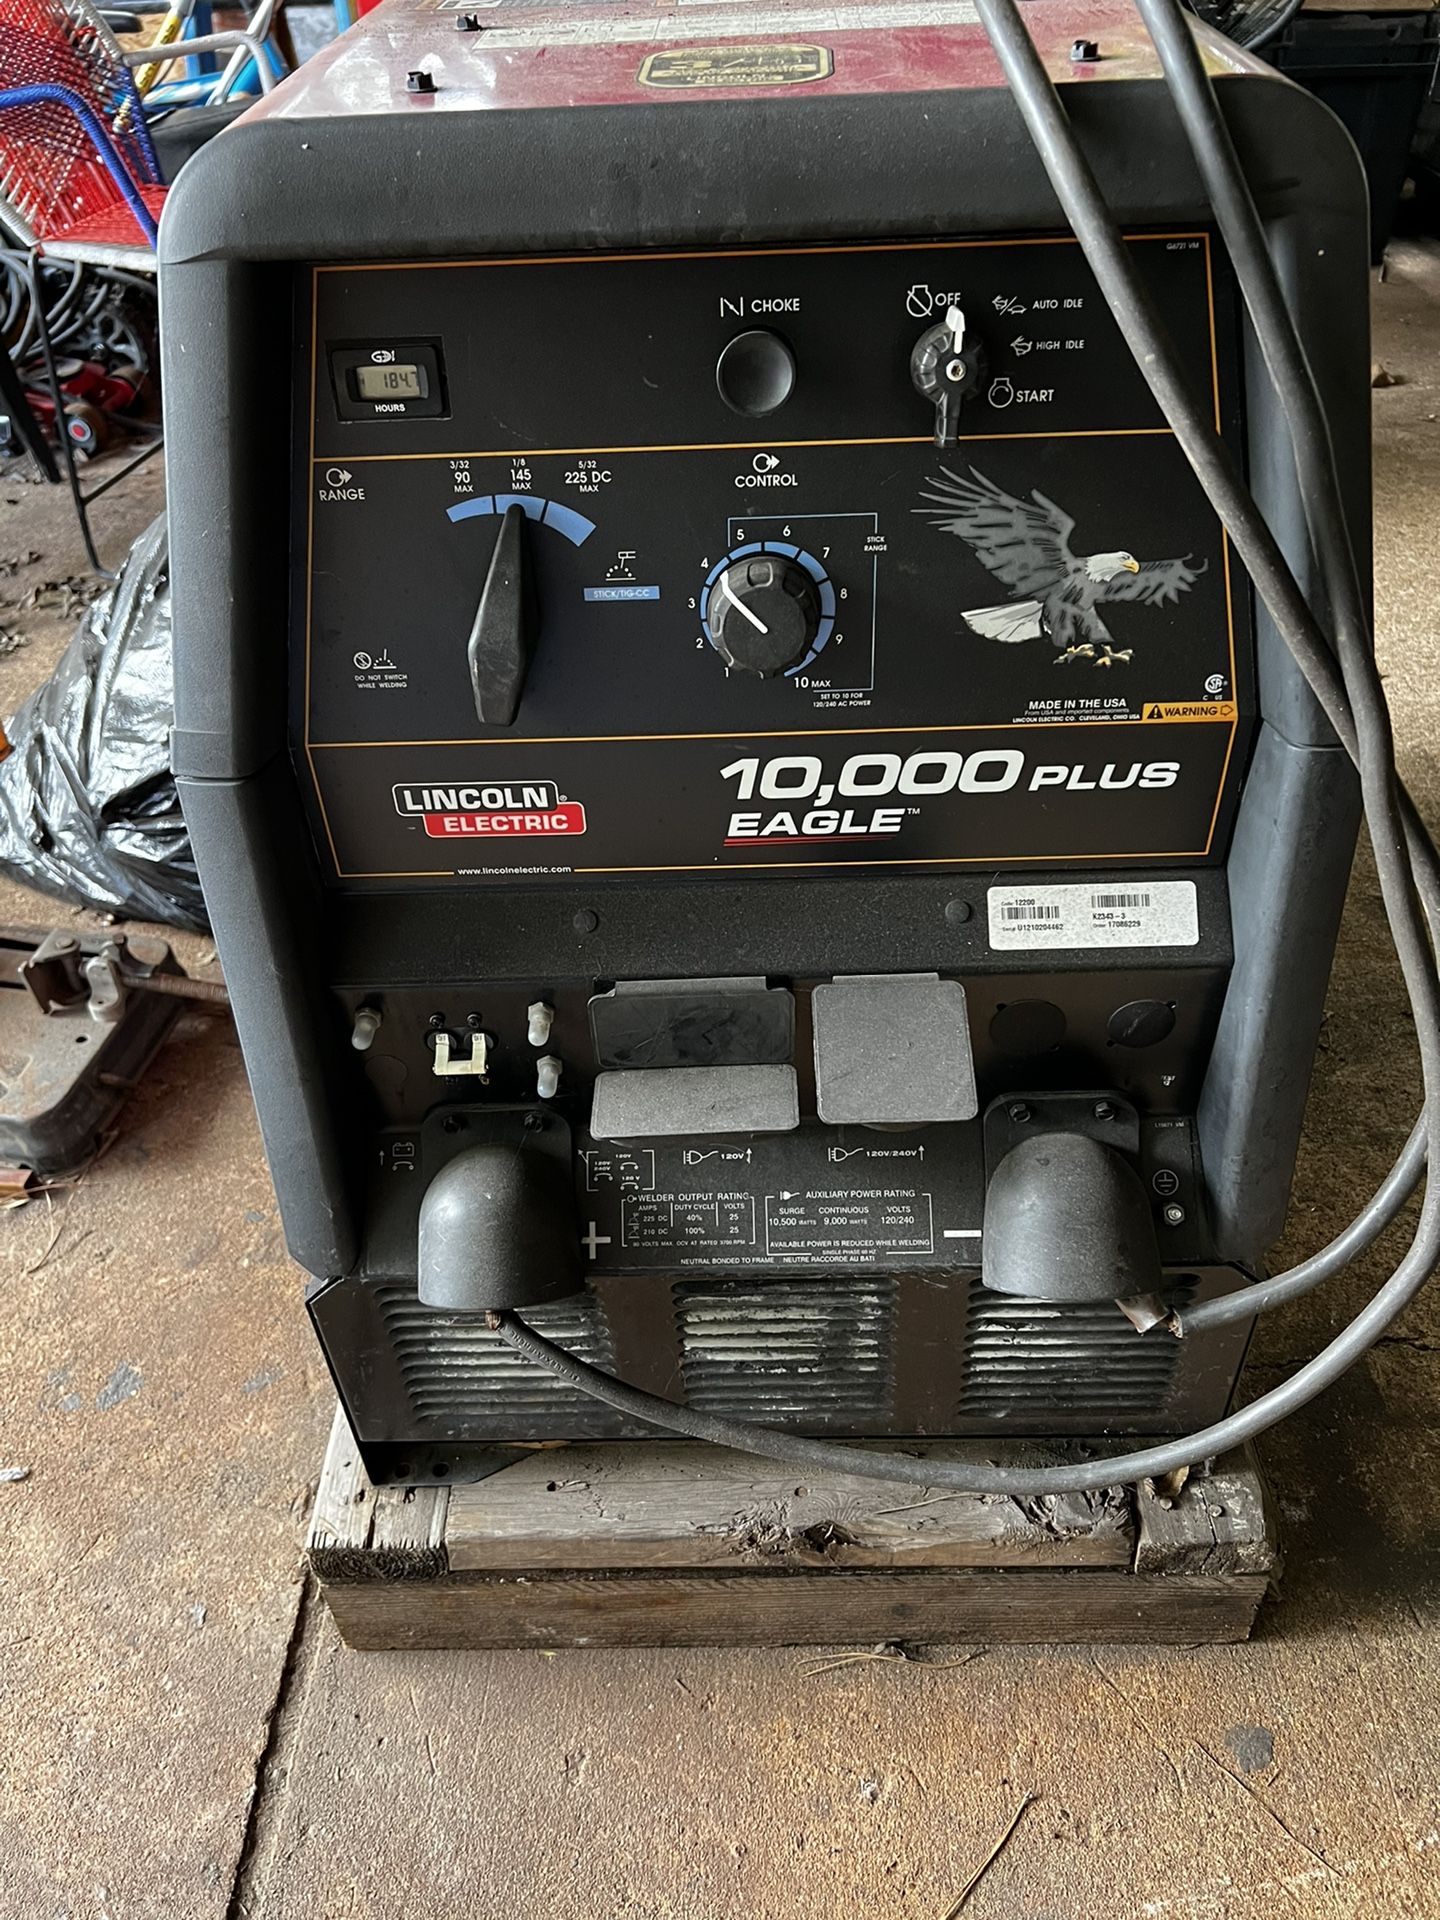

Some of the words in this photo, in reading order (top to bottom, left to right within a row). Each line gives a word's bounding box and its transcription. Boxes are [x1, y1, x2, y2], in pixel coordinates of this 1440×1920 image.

[935, 292, 961, 306] OFF
[1033, 299, 1058, 309] AUTO
[1063, 298, 1083, 308] IDLE
[751, 298, 800, 313] CHOKE
[1036, 340, 1060, 350] HIGH
[1065, 340, 1085, 350] IDLE
[1016, 389, 1055, 403] START
[375, 403, 406, 413] HOURS
[450, 460, 470, 470] 3/32
[512, 458, 526, 467] 1/8
[578, 460, 597, 469] 5/32
[454, 471, 471, 484] 90
[510, 469, 532, 482] 145
[564, 472, 588, 484] 225
[591, 470, 612, 483] DC
[734, 474, 798, 488] CONTROL
[454, 485, 474, 493] MAX
[512, 482, 532, 490] MAX
[579, 485, 599, 493] MAX
[319, 488, 366, 501] RANGE
[736, 528, 745, 540] 5
[783, 525, 792, 537] 6
[823, 547, 831, 558] 7
[700, 557, 709, 569] 4
[593, 589, 650, 599] STICK/TIG-CC
[840, 588, 848, 599] 8
[688, 598, 696, 609] 3
[696, 638, 704, 649] 2
[835, 634, 843, 645] 9
[794, 676, 809, 688] 10
[811, 680, 831, 688] MAX
[1028, 700, 1062, 710] MADE
[1063, 700, 1076, 709] IN
[1079, 699, 1101, 708] THE
[1103, 698, 1127, 707] USA
[1165, 706, 1217, 717] WARNING
[719, 749, 1025, 806] 10,000
[1028, 761, 1180, 792] PLUS
[402, 786, 549, 811] LINCOLN
[442, 814, 569, 833] ELECTRIC
[727, 808, 905, 838] EAGLE
[457, 866, 572, 876] www.lincolnelectric.com
[720, 1152, 745, 1160] 120V
[866, 1150, 917, 1158] 120V/240V
[637, 1194, 675, 1202] WELDER
[678, 1193, 714, 1201] OUTPUT
[717, 1192, 750, 1200] RATING
[805, 1190, 849, 1199] AUXILIARY
[850, 1190, 882, 1198] POWER
[883, 1189, 916, 1197] RATING
[779, 1207, 806, 1215] SURGE
[818, 1206, 870, 1214] CONTINUOUS
[886, 1205, 912, 1213] VOLTS
[686, 1214, 703, 1222] 40%
[729, 1213, 739, 1221] 25
[769, 1218, 797, 1226] 10,500
[823, 1217, 848, 1225] 9,000
[880, 1216, 915, 1224] 120/240
[685, 1227, 705, 1235] 100%
[729, 1226, 739, 1234] 25
[841, 1239, 875, 1247] REDUCED
[899, 1238, 931, 1246] WELDING
[811, 1255, 848, 1263] RACCORDE
